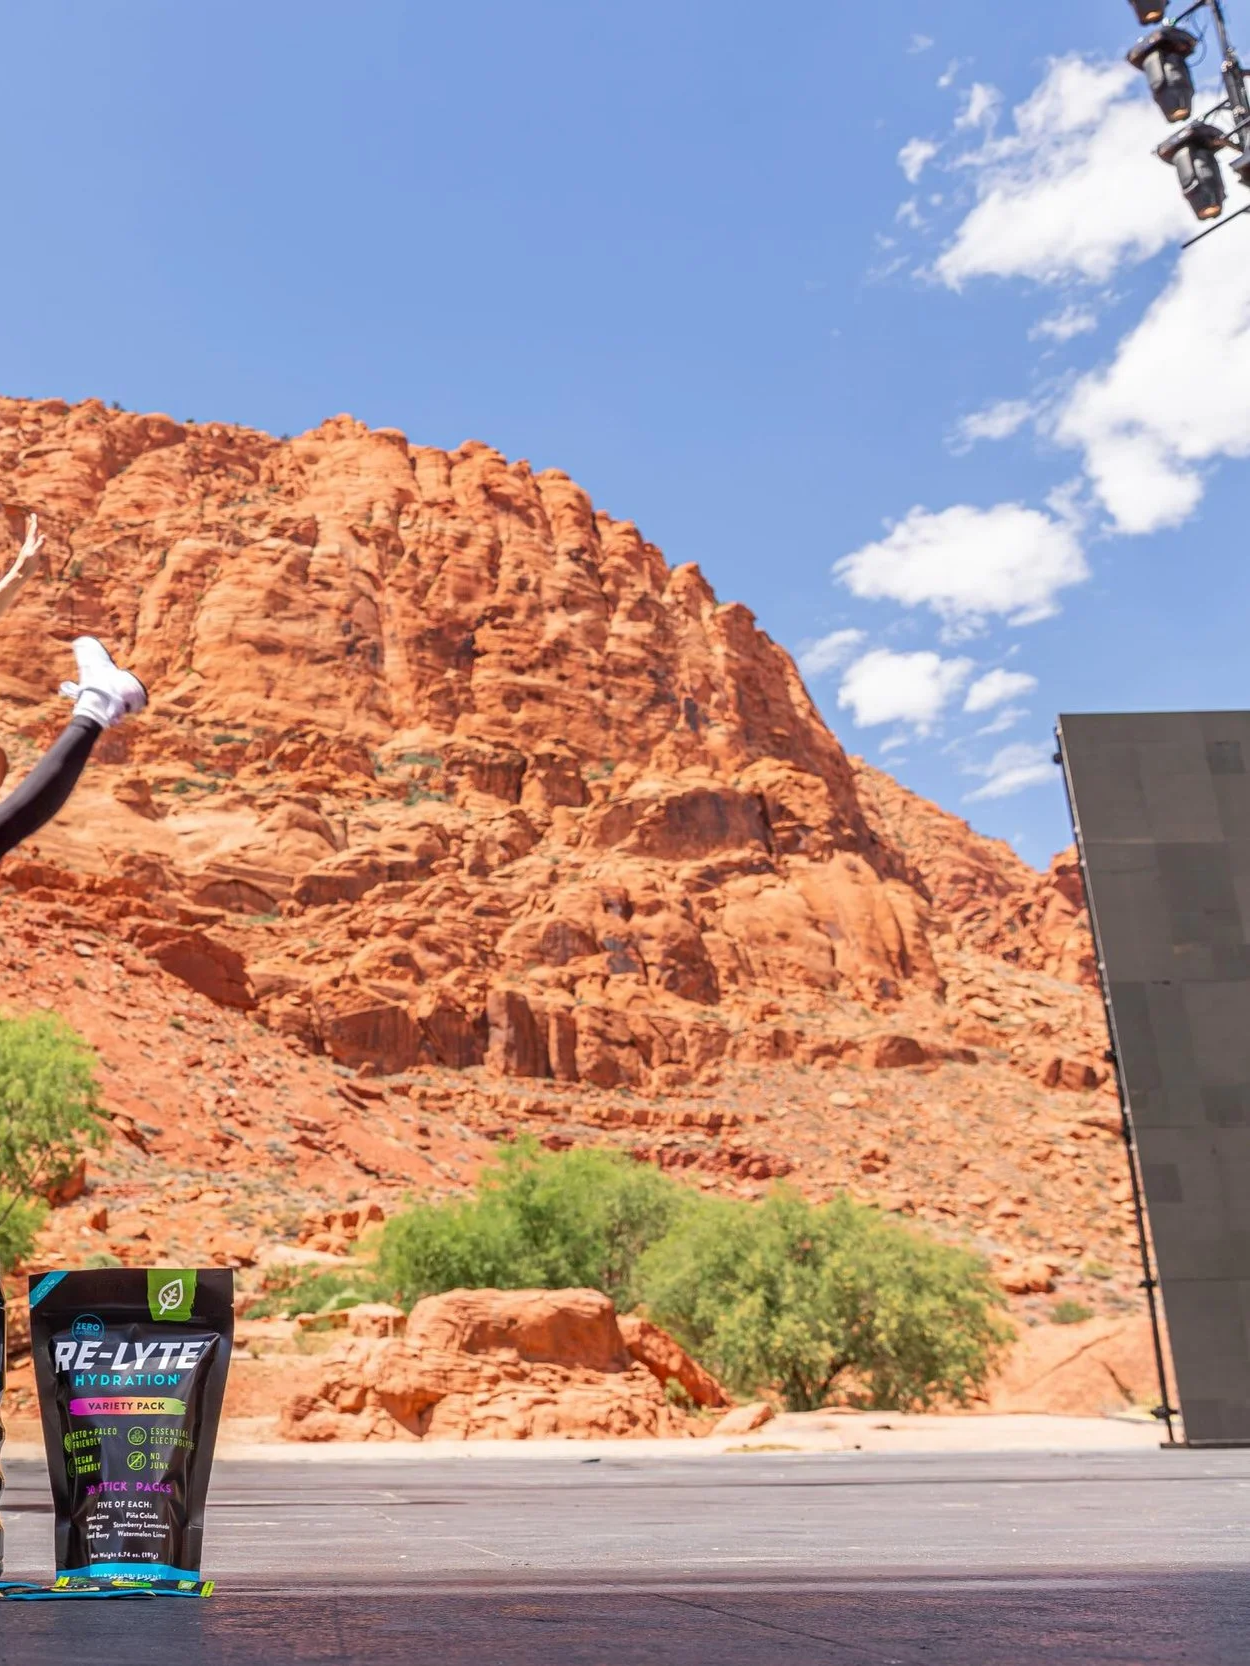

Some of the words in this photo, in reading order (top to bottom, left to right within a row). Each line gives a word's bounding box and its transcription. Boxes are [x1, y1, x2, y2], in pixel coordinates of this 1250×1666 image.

[76, 1322, 100, 1331] ZERO
[89, 1402, 133, 1411] VARIETY
[137, 1402, 165, 1411] PACK
[95, 1427, 118, 1437] PALEO
[151, 1428, 190, 1439] ESSENTIAL
[72, 1437, 101, 1451] FRIENDLY
[150, 1452, 160, 1460] NO
[150, 1462, 169, 1471] JUNK
[98, 1481, 127, 1493] STICK
[136, 1481, 171, 1493] PACKS
[127, 1501, 152, 1509] EACH:
[140, 1512, 158, 1520] Colada
[113, 1521, 142, 1530] Strawberry
[143, 1521, 170, 1530] Lemonade
[117, 1530, 151, 1538] Watermelon
[99, 1552, 117, 1560] Weight
